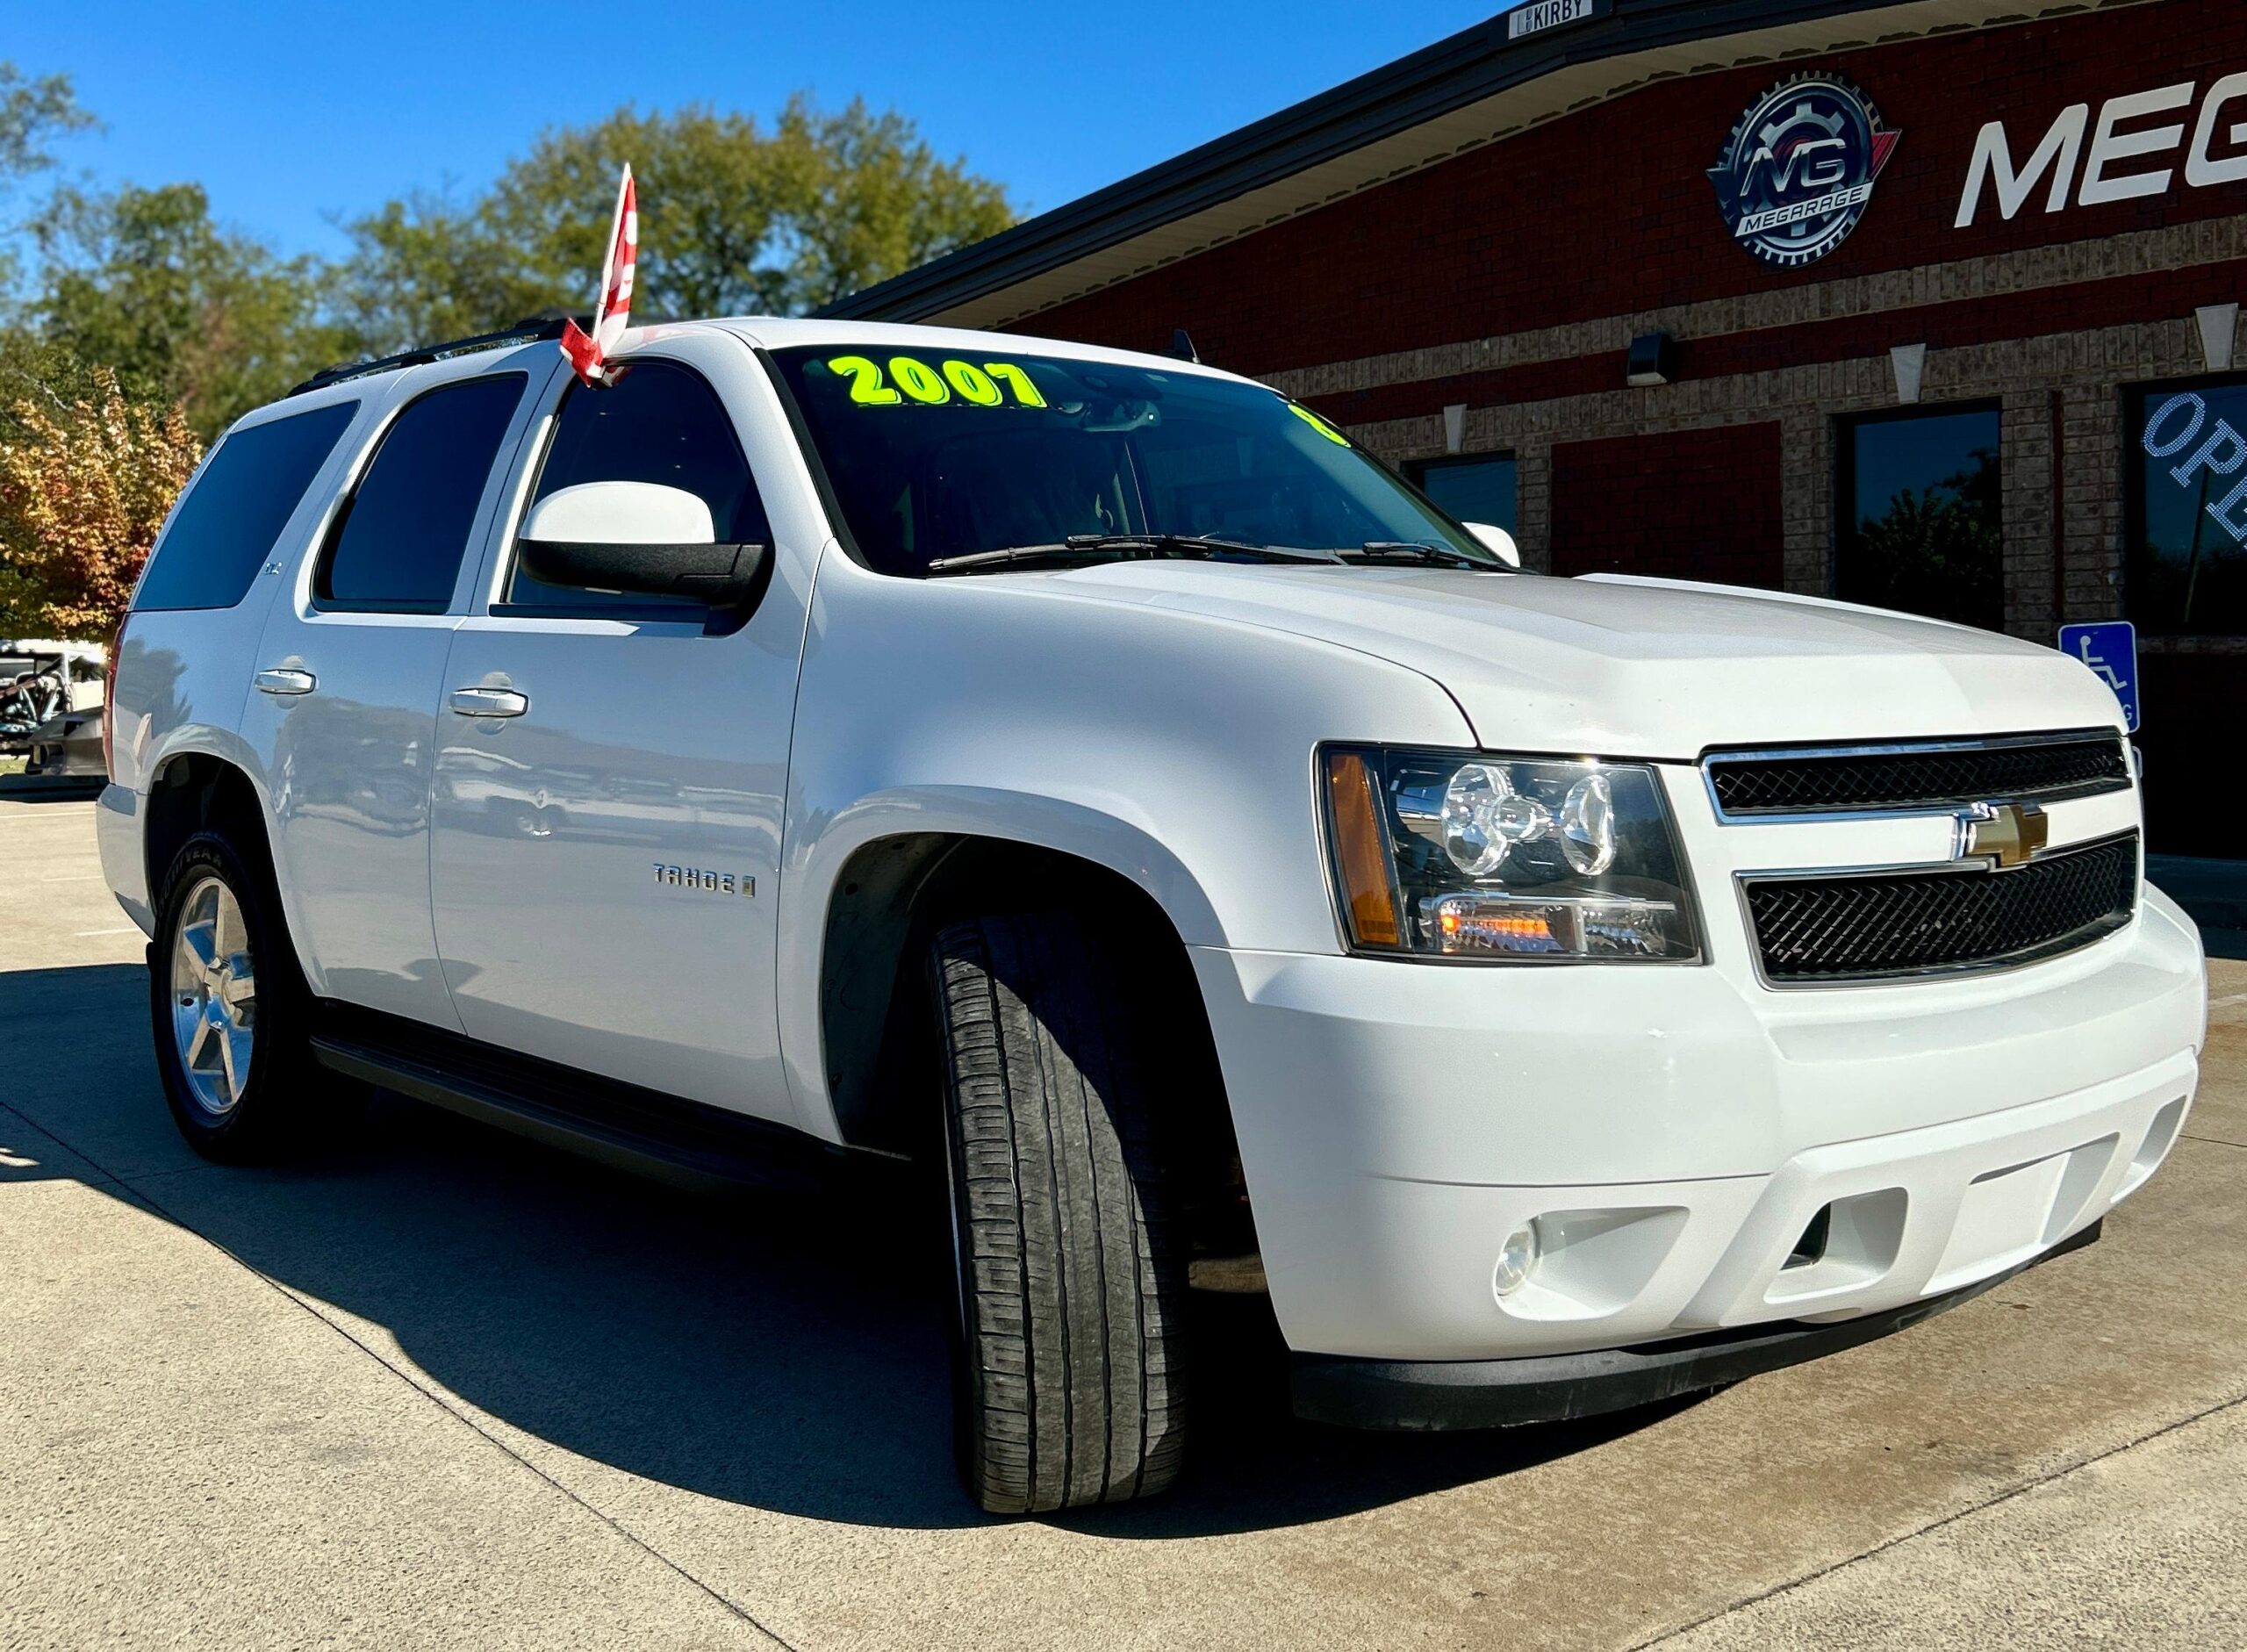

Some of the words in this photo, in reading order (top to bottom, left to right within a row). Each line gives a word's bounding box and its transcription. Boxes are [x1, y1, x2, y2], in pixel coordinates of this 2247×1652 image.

[1534, 0, 1582, 30] KIRBY
[1744, 186, 1863, 233] MEGARAGE
[828, 356, 1048, 408] 2007
[652, 863, 735, 894] TAHOE
